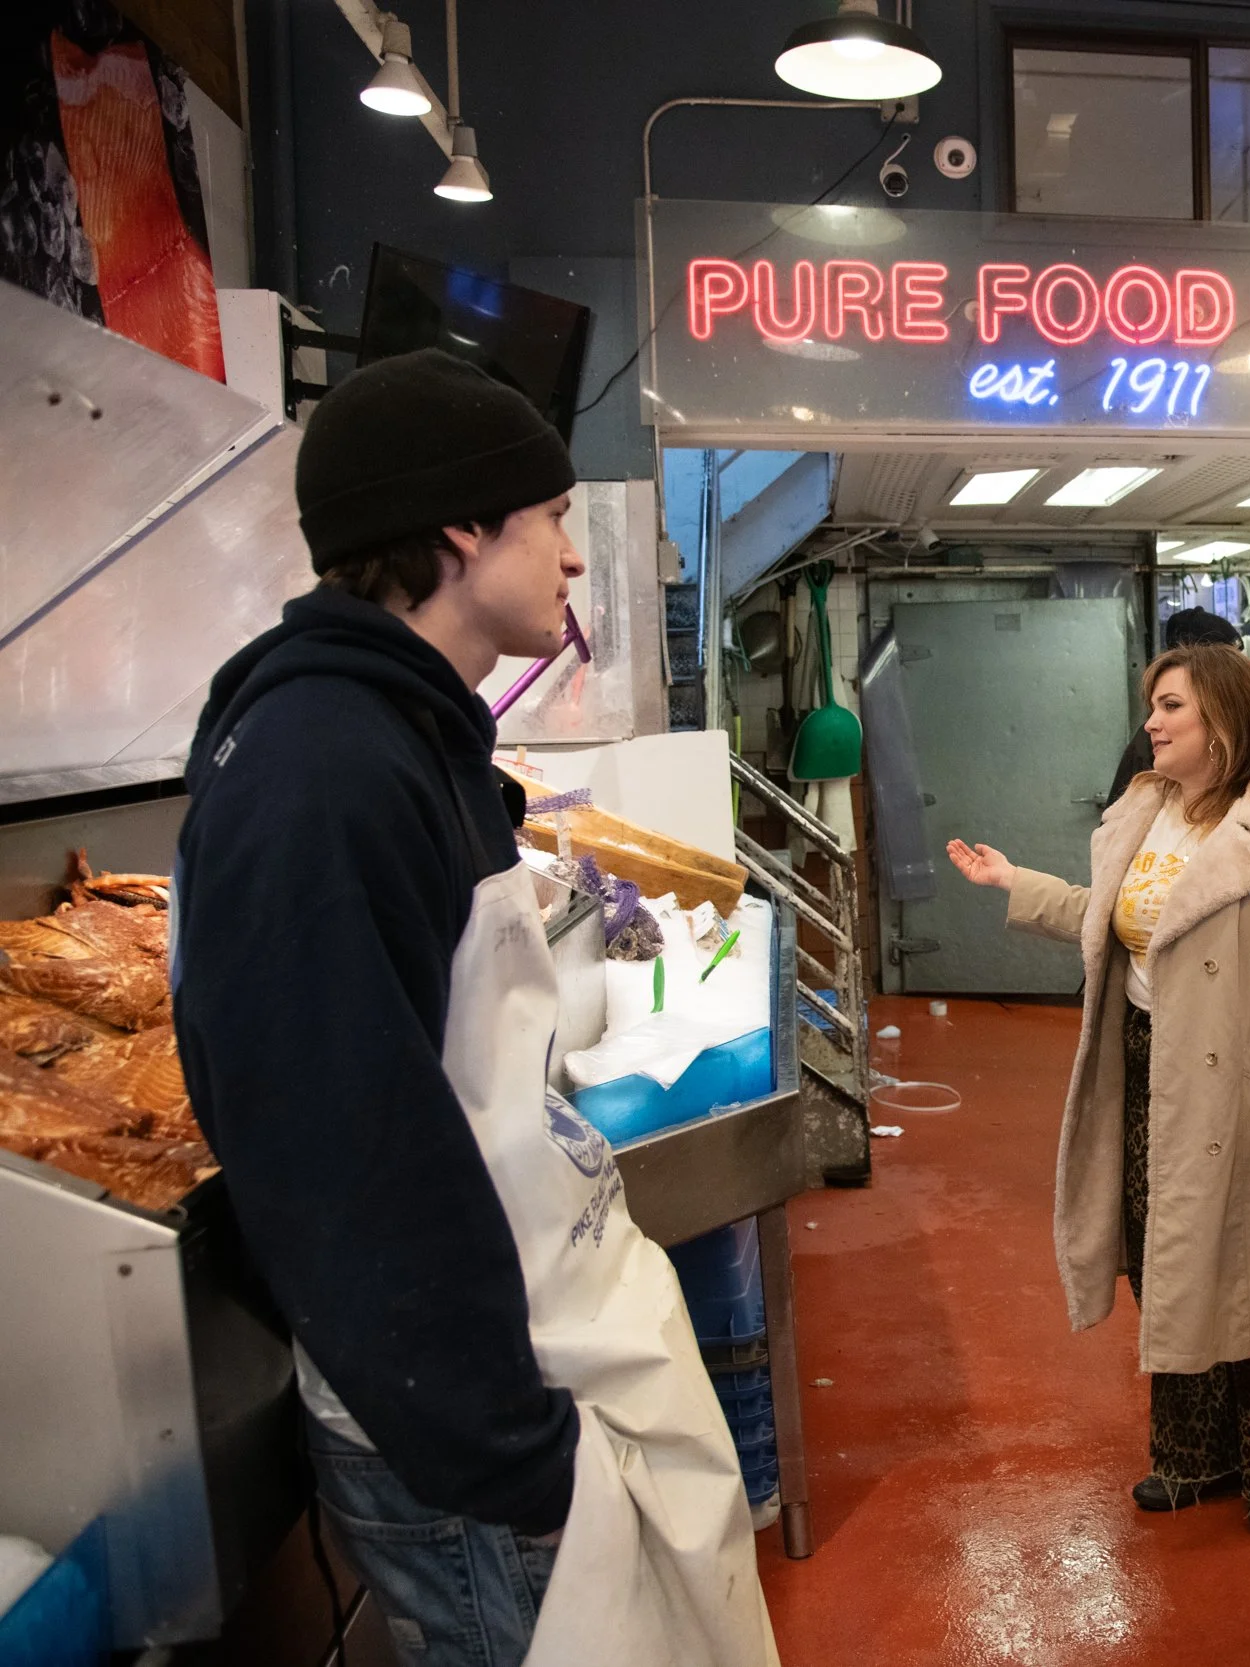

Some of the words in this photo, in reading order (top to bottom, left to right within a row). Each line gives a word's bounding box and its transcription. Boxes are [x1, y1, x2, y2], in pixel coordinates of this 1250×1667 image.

[686, 257, 950, 344] PURE
[977, 262, 1235, 347] FOOD
[968, 358, 1059, 406] est.
[1102, 356, 1212, 416] 1911
[571, 1206, 593, 1248] PIKE
